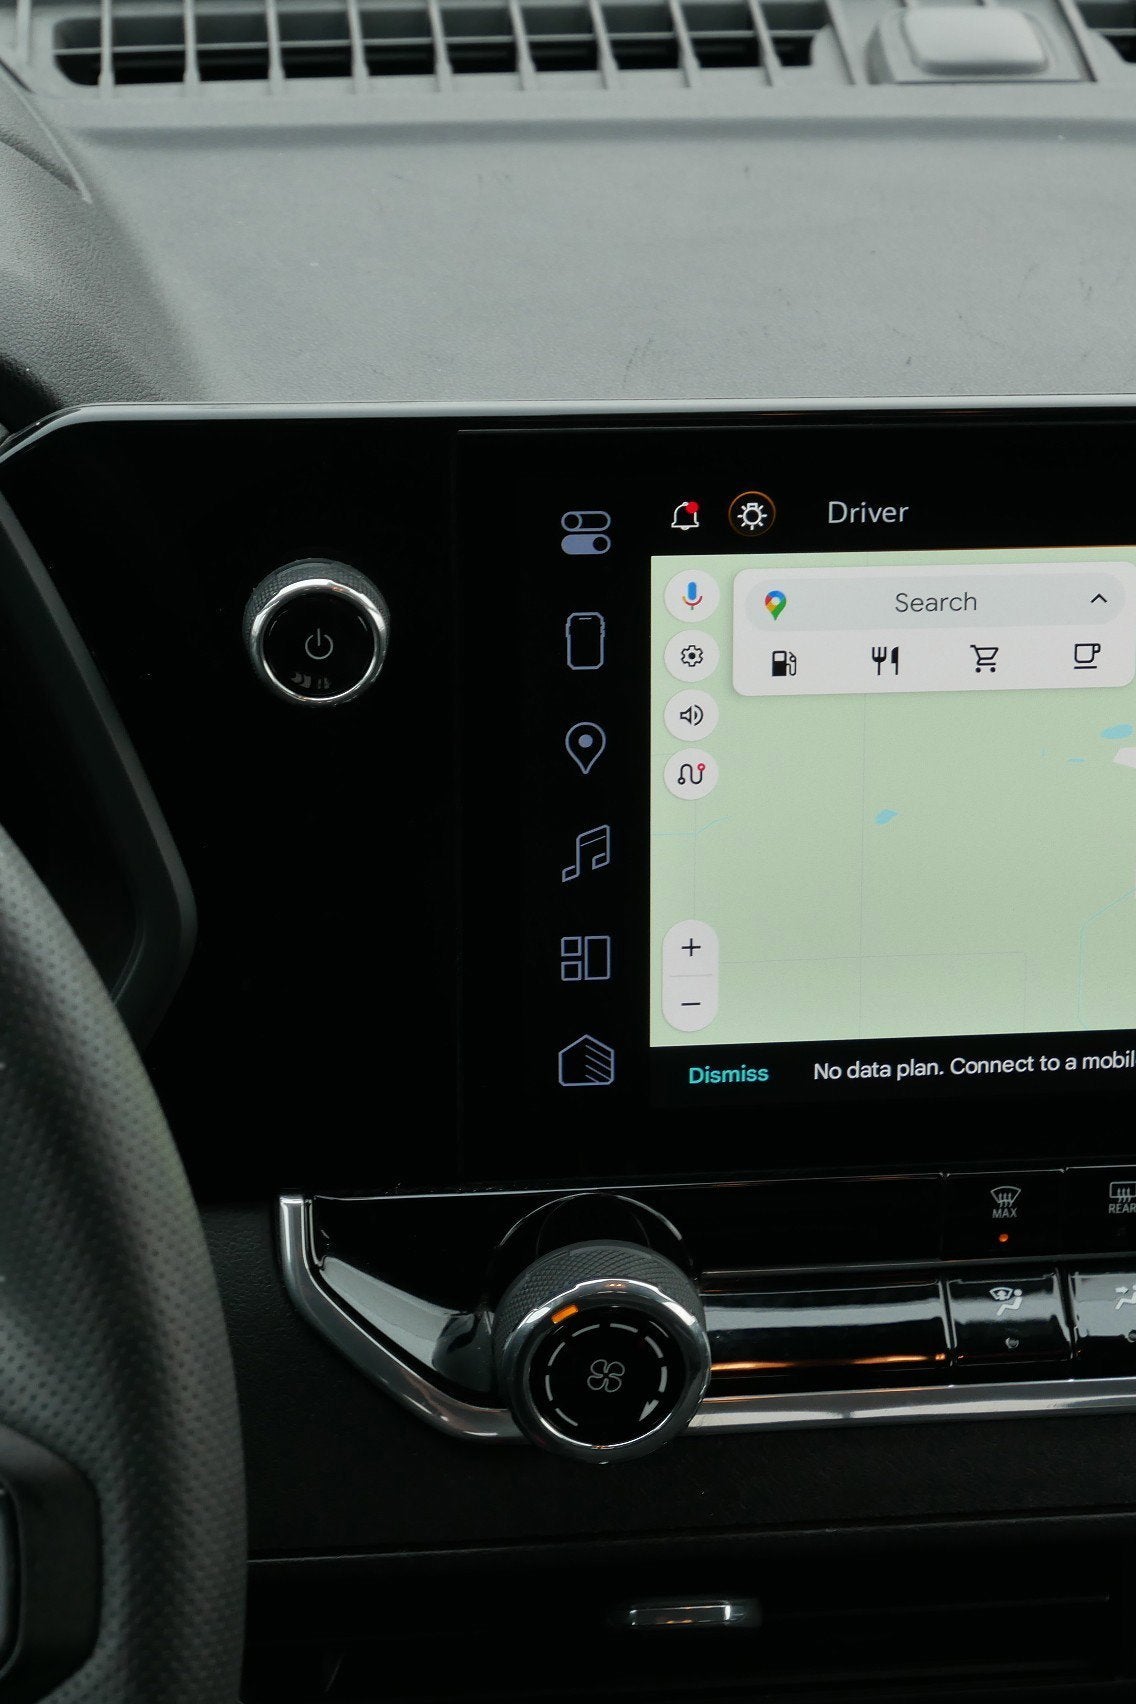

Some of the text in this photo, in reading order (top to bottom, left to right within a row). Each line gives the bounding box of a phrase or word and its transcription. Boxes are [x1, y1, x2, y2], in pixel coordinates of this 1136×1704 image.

[827, 500, 909, 525] Driver
[894, 590, 978, 614] Search
[688, 1064, 770, 1085] Dismiss
[814, 1062, 842, 1080] No
[846, 1060, 892, 1079] data
[896, 1059, 944, 1082] plan.
[950, 1055, 1035, 1076] Connect
[1040, 1054, 1061, 1072] to
[1064, 1057, 1078, 1072] a
[991, 1207, 1018, 1219] MAX
